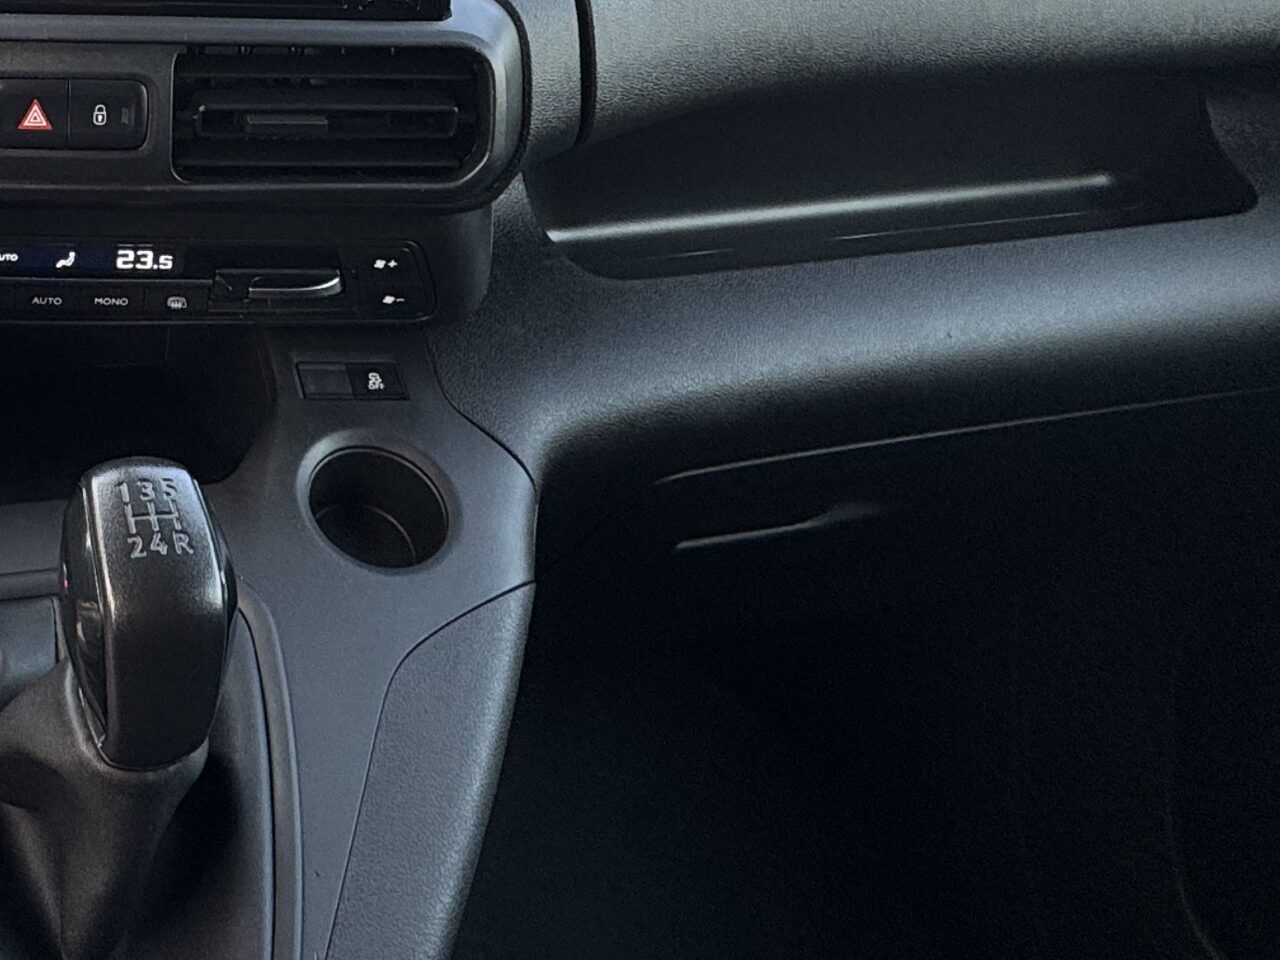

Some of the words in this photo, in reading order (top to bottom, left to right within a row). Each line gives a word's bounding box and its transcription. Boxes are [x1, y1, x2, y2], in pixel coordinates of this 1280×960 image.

[116, 248, 173, 270] 23.5
[31, 296, 62, 306] AUTO
[94, 297, 129, 306] MONO
[171, 530, 195, 555] R
